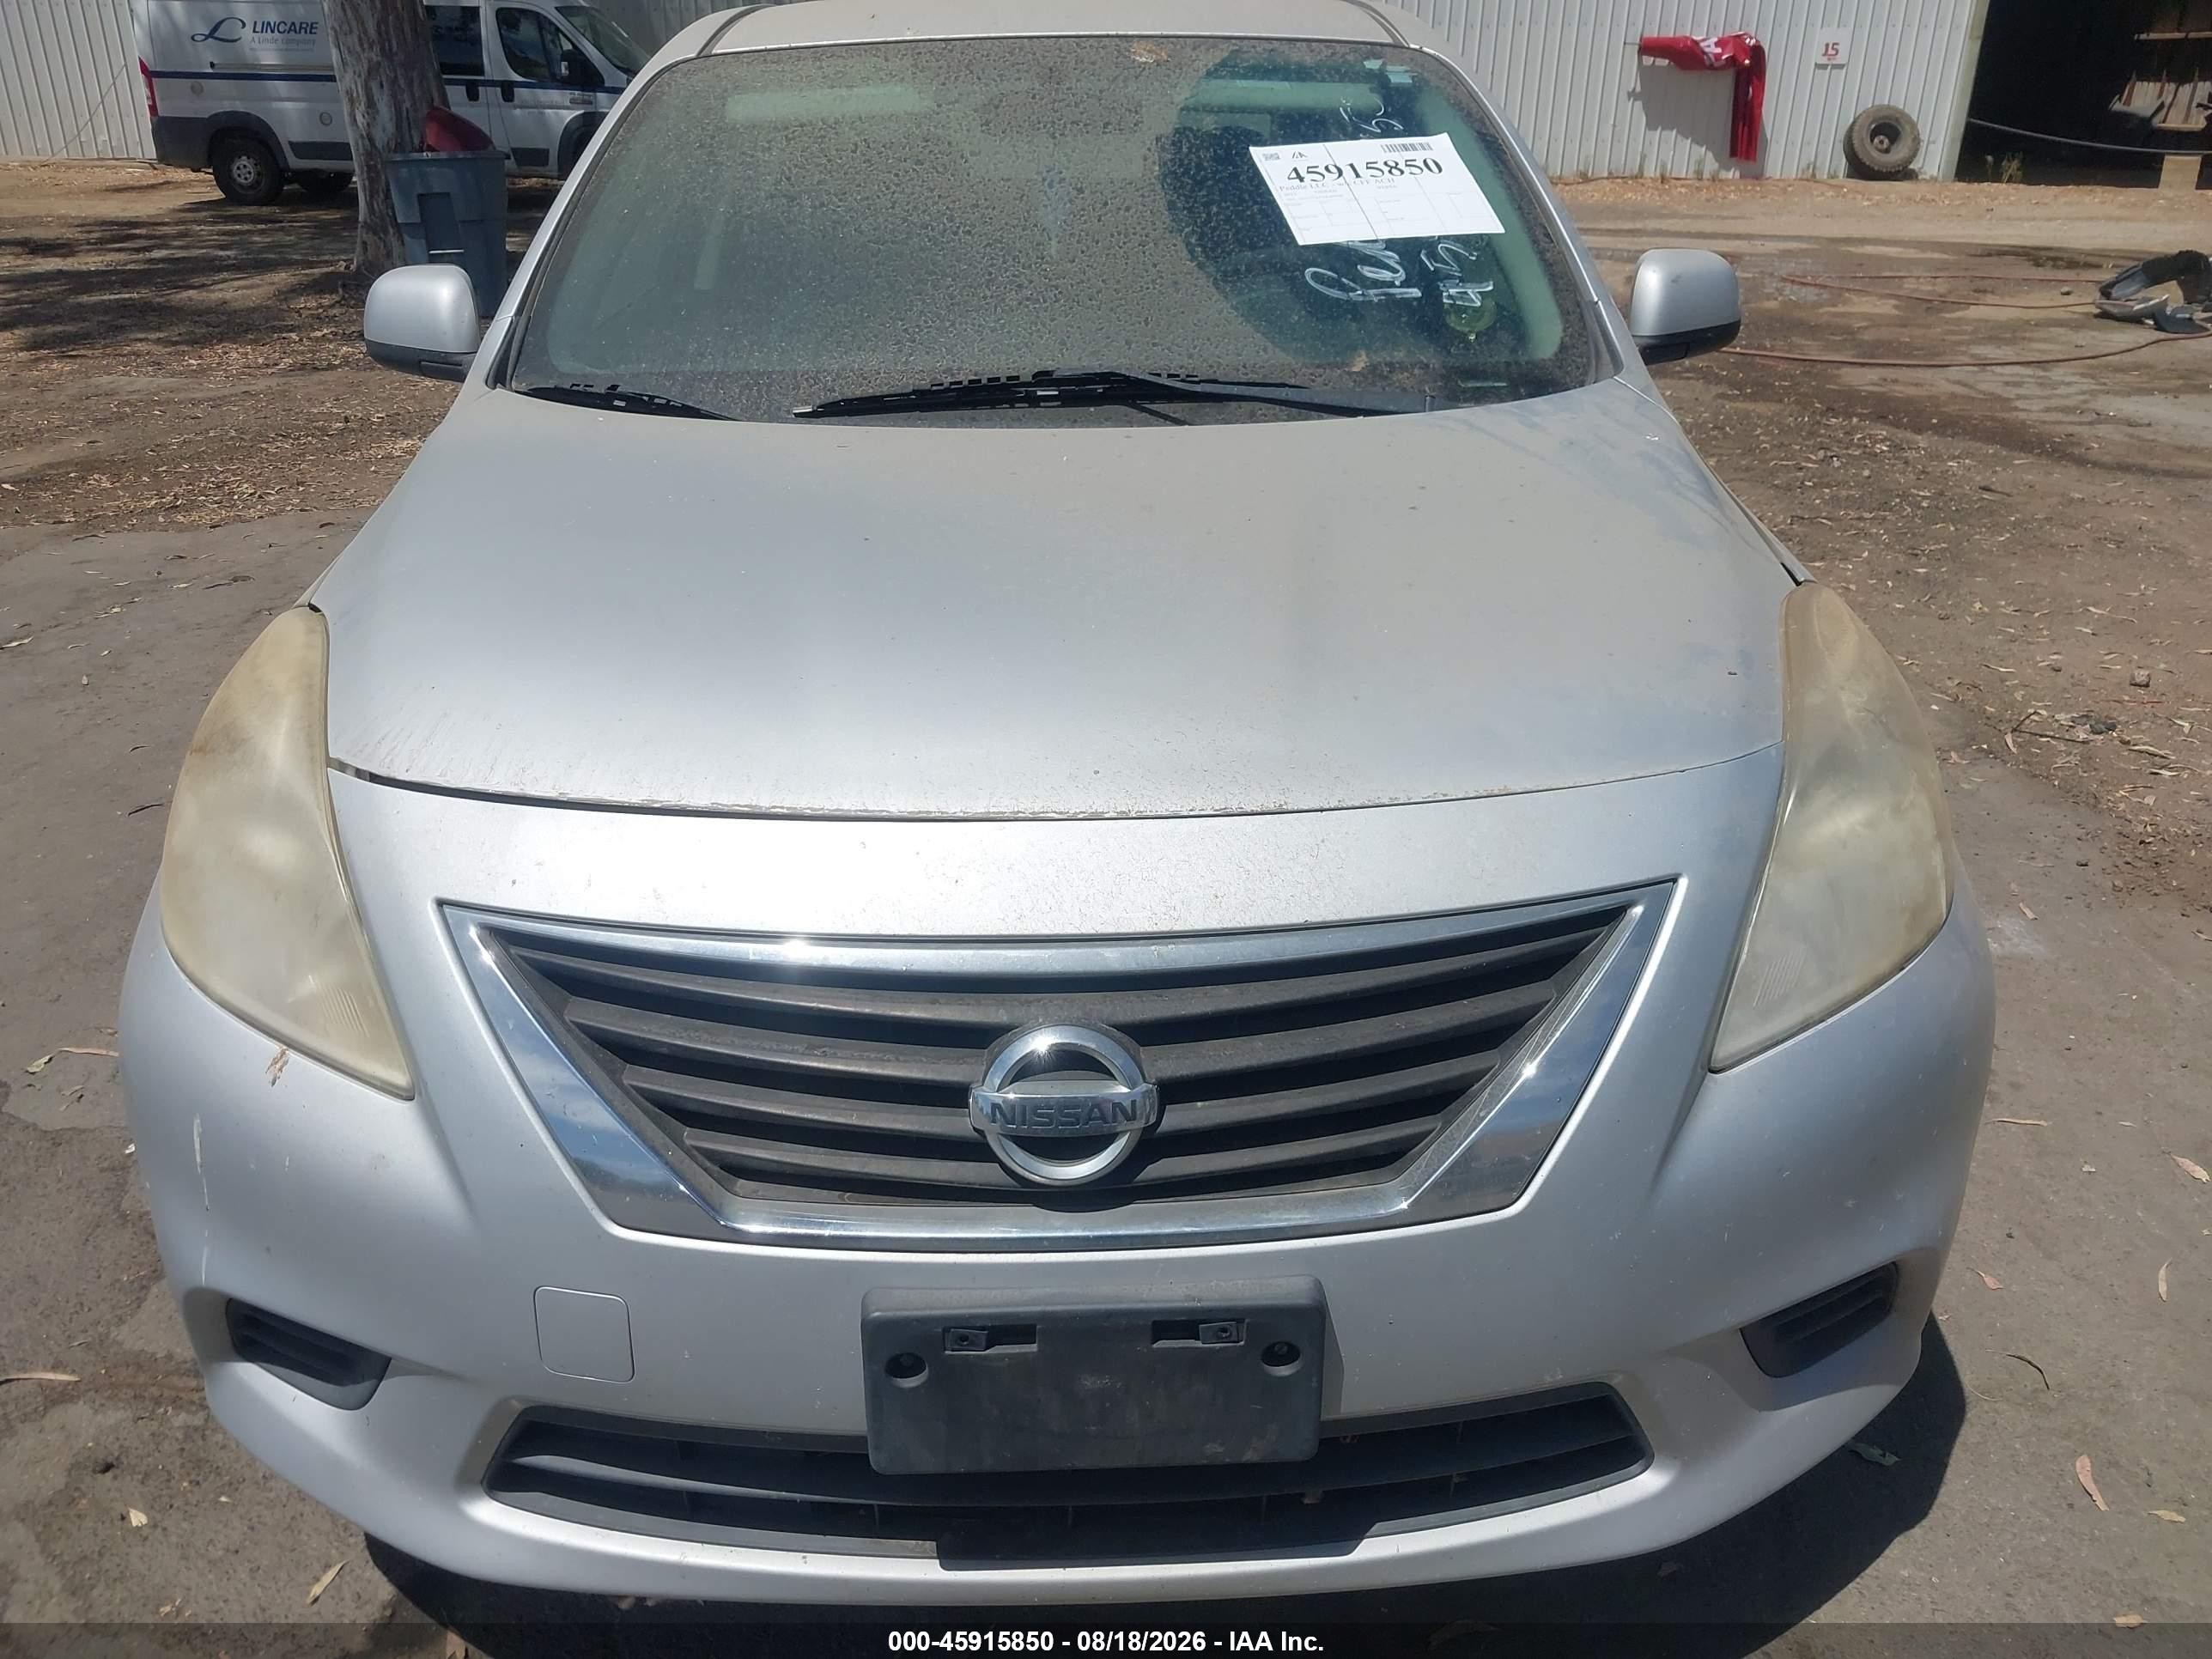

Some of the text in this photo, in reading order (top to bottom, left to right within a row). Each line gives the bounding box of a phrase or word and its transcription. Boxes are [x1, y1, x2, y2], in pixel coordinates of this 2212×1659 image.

[252, 21, 319, 34] LINCARE
[1821, 42, 1839, 57] 15
[1287, 157, 1443, 183] 45915850
[990, 1100, 1138, 1129] NISSAN
